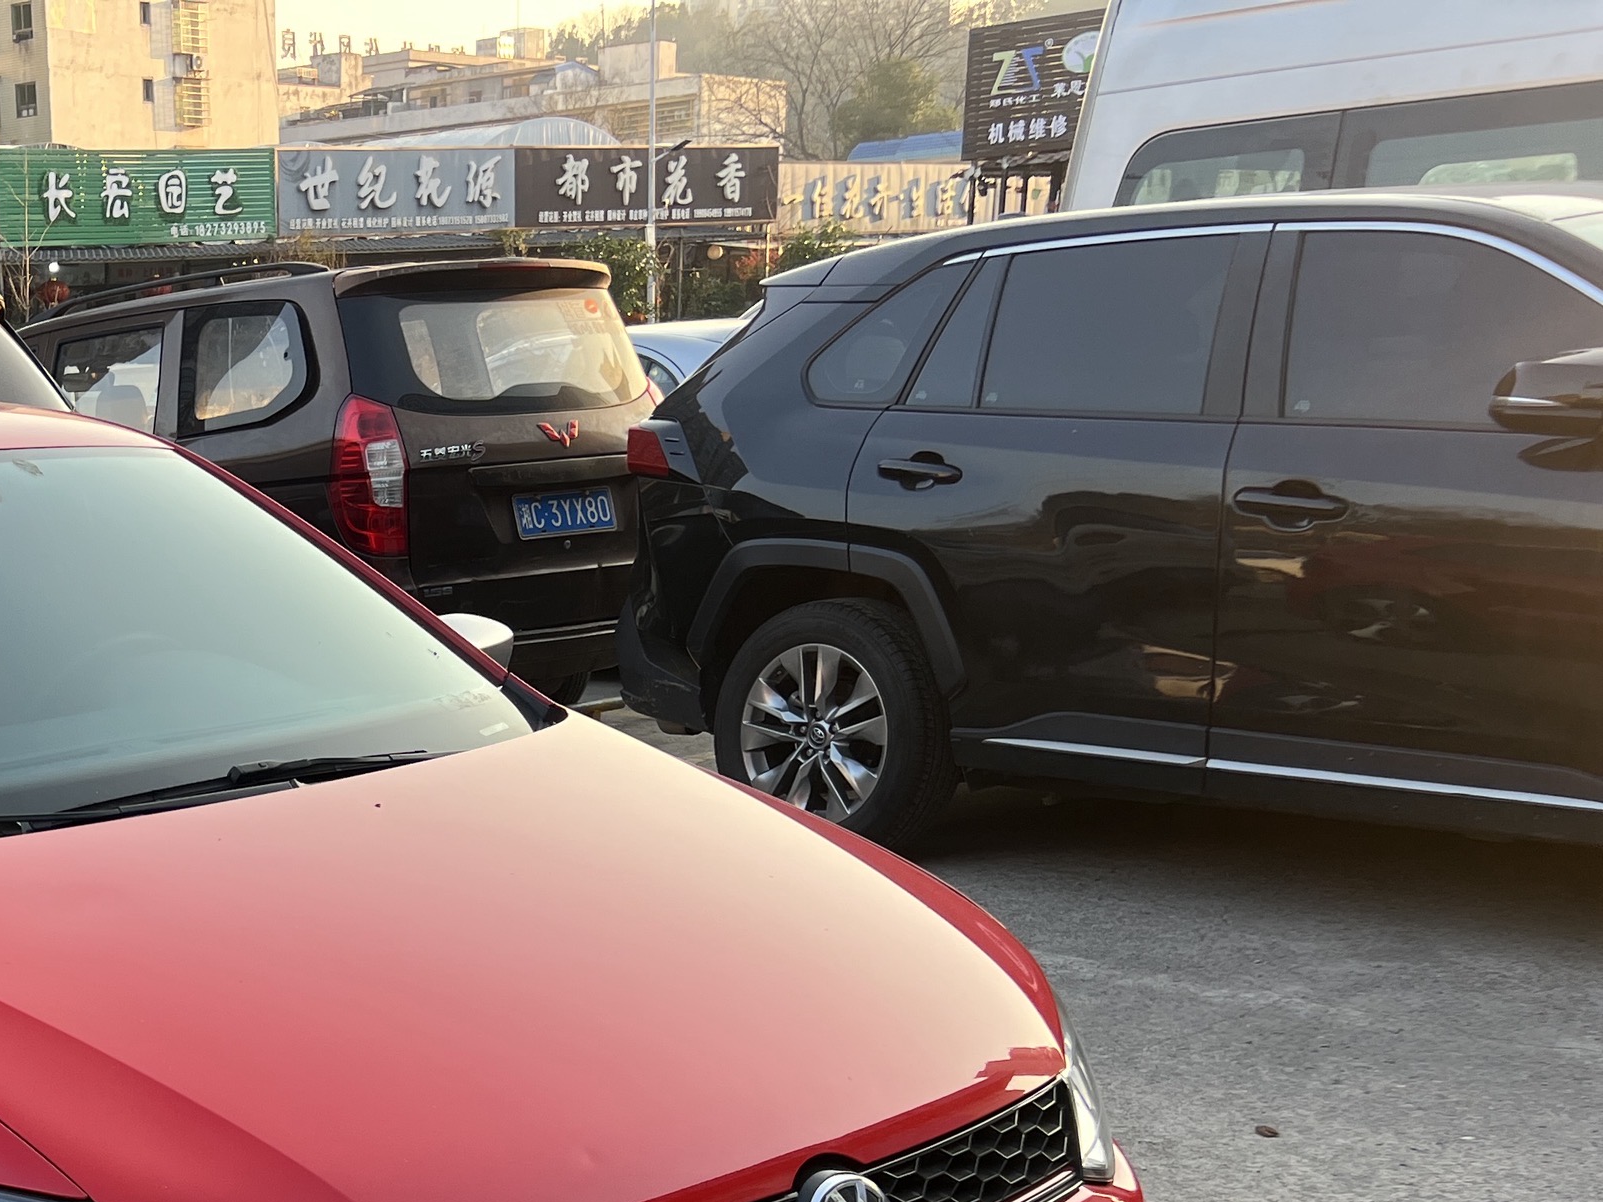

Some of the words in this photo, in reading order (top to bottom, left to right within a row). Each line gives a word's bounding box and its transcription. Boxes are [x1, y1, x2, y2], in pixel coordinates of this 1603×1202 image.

[988, 115, 1067, 144] 机械维修
[299, 155, 502, 211] 世纪花源
[556, 153, 746, 206] 都市花香
